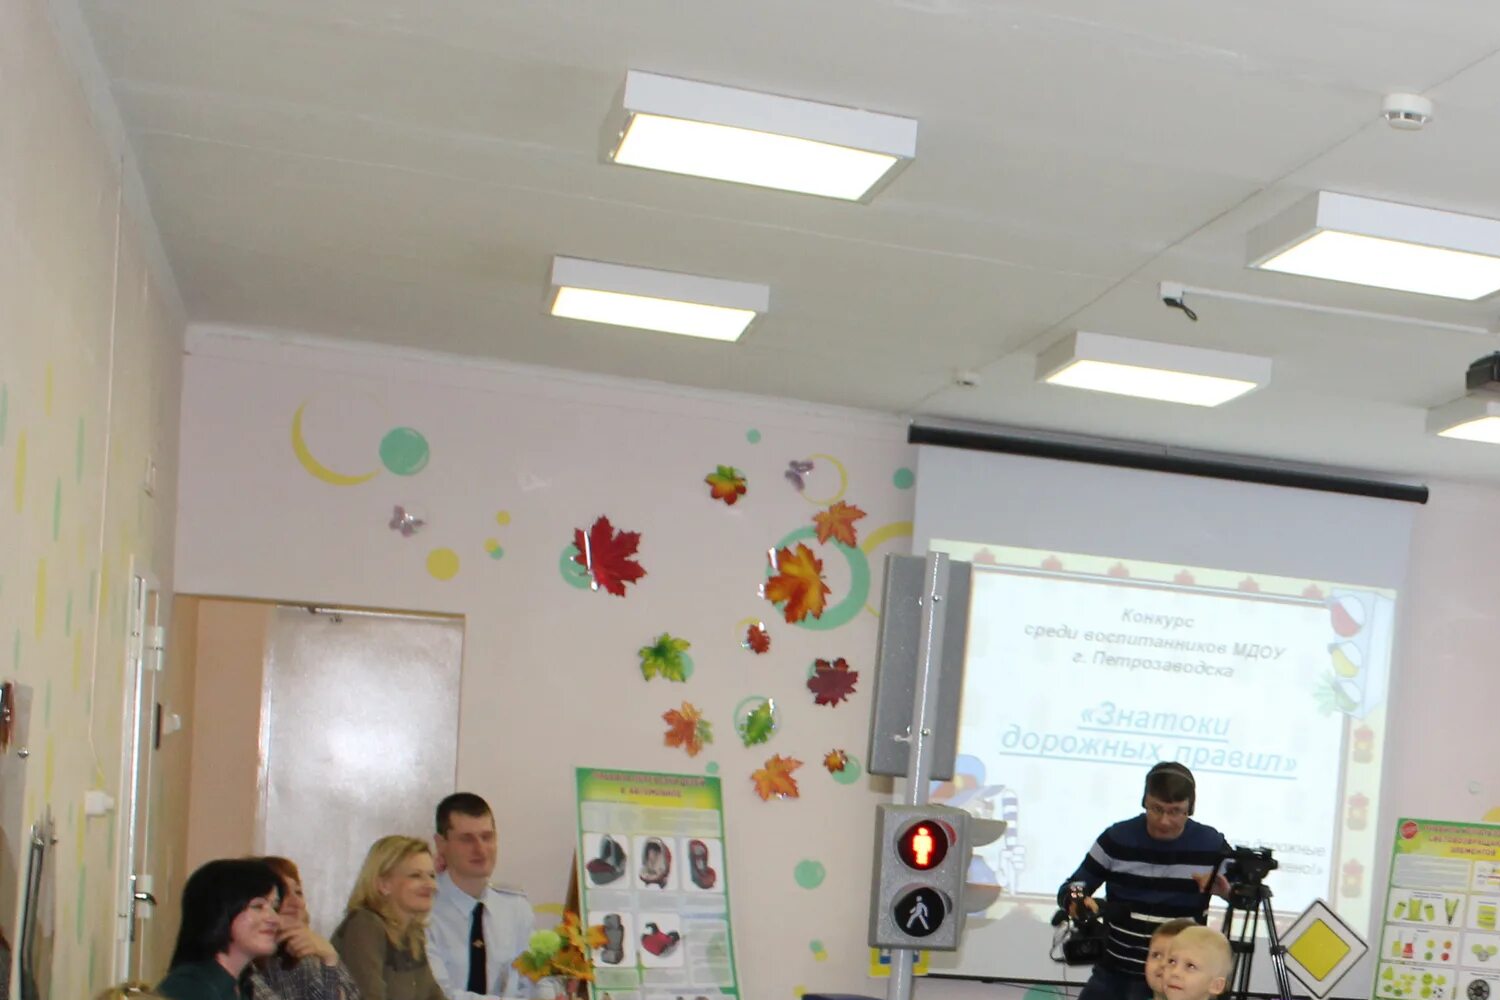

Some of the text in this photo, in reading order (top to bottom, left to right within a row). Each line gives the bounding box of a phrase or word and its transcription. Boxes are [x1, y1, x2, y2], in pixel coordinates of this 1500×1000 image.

[1121, 607, 1195, 630] Конкурс
[1023, 622, 1288, 662] среди воспитанников МДОУ
[1071, 650, 1235, 679] г. Петрозаводска
[1079, 700, 1232, 737] «Знатоки
[1000, 723, 1299, 775] дорожных правил»
